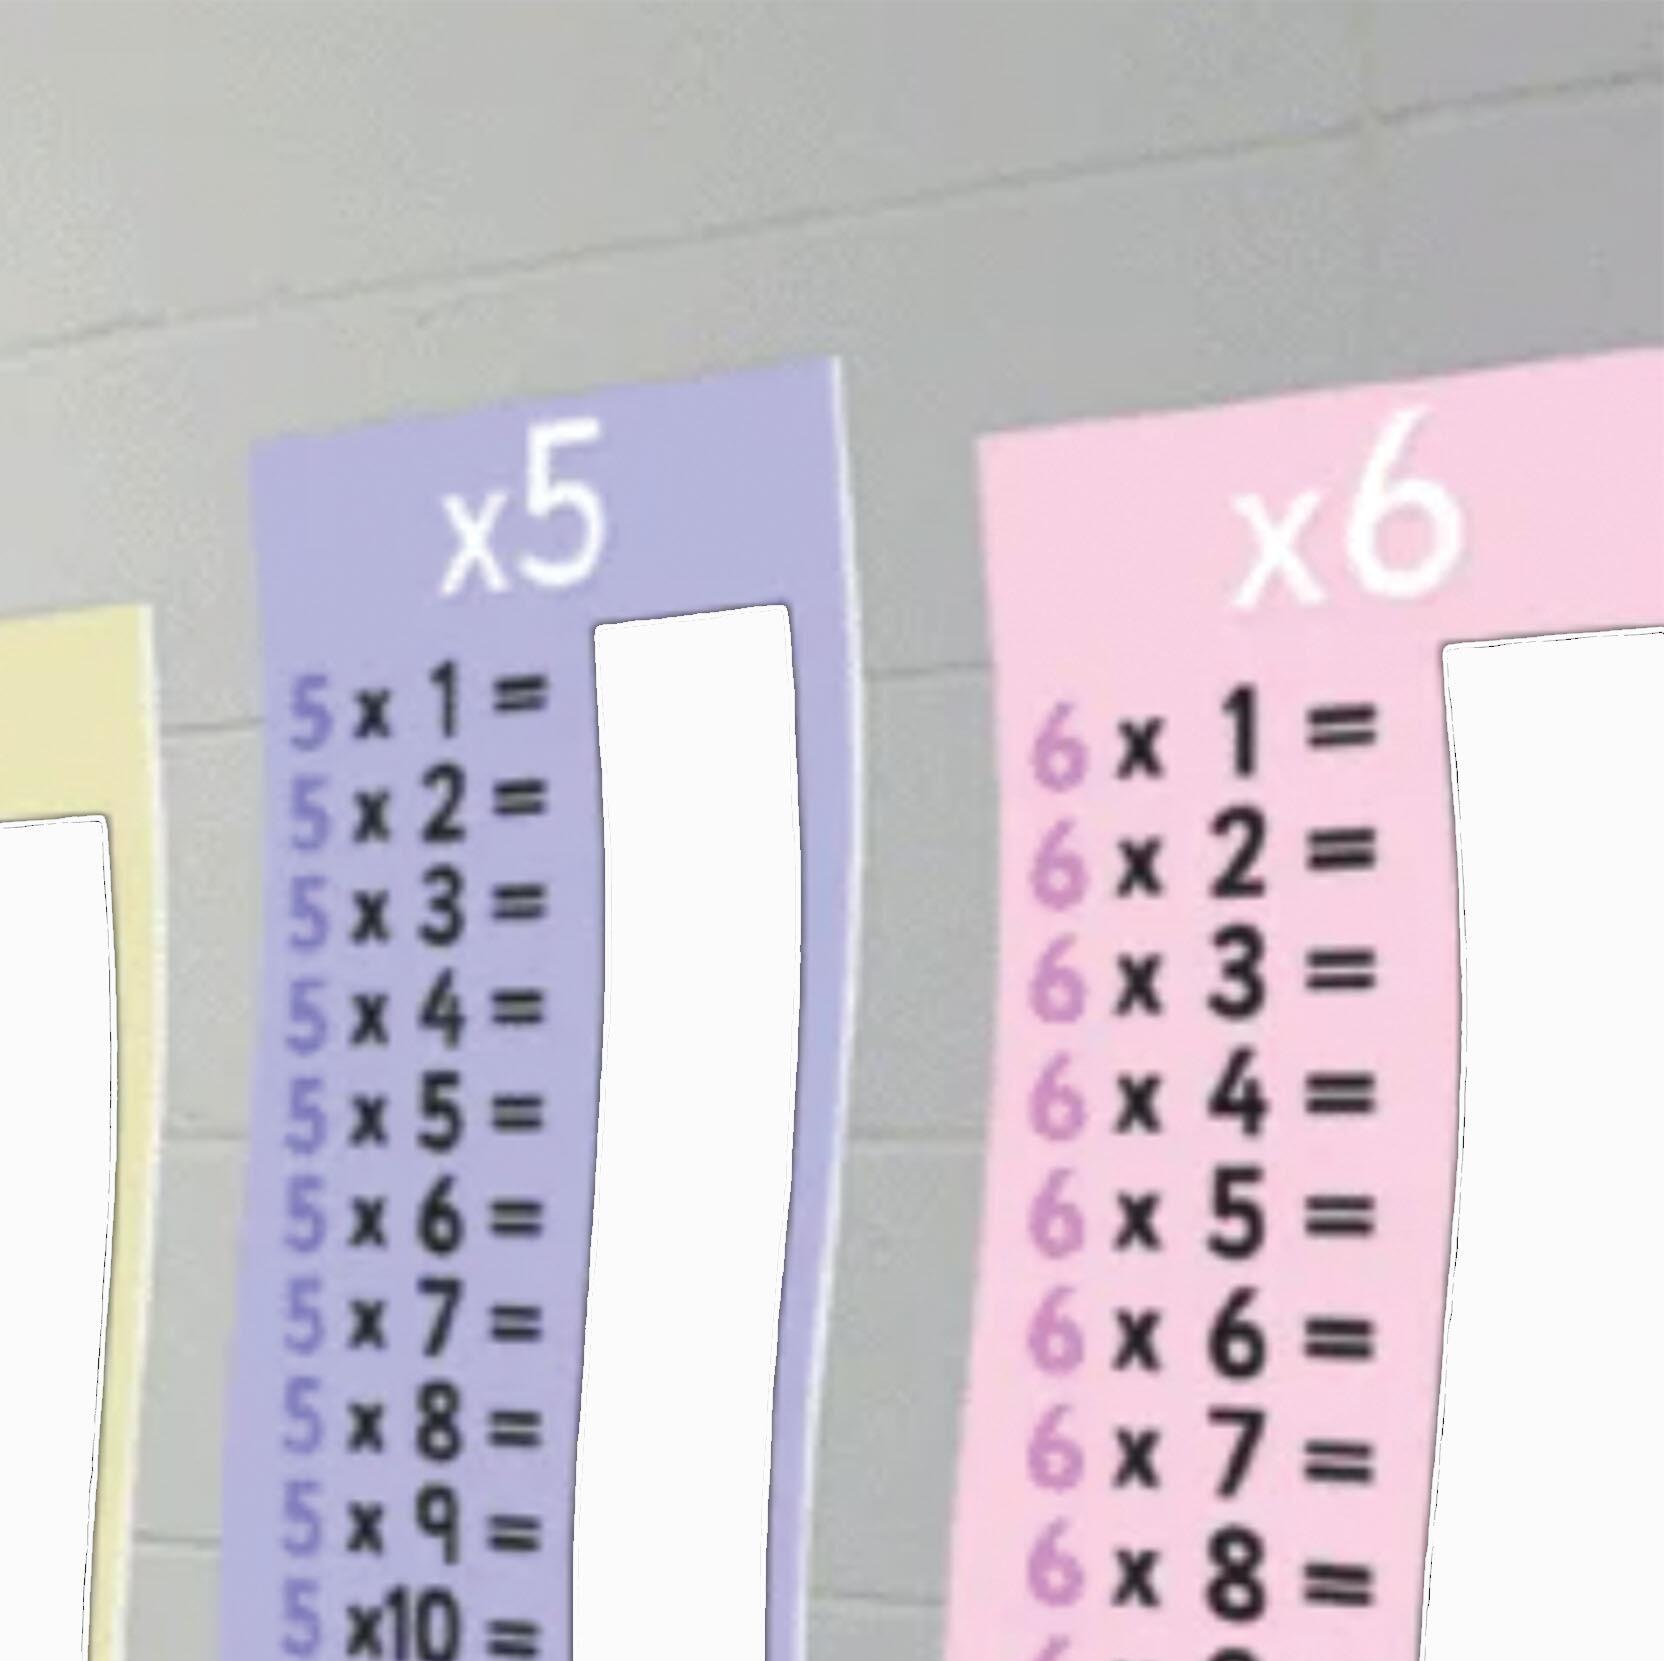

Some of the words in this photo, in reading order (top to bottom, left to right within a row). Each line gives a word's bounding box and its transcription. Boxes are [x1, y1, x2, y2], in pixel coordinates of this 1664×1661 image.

[439, 417, 606, 596] x5
[1229, 406, 1463, 608] x6
[290, 673, 334, 752] 5
[354, 689, 390, 739] x
[429, 659, 458, 739] 1
[1031, 702, 1088, 793] 6
[1117, 717, 1163, 779] x
[1222, 684, 1257, 778] 1
[291, 774, 331, 853] 5
[353, 790, 390, 843] x
[421, 762, 466, 844] 2
[1029, 819, 1089, 912] 6
[1117, 837, 1163, 898] x
[1210, 804, 1267, 899] 2
[289, 874, 330, 954] 5
[351, 891, 390, 944] x
[418, 863, 465, 948] 3
[285, 977, 329, 1057] 5
[350, 993, 389, 1045] x
[418, 968, 467, 1048] 4
[1029, 935, 1087, 1024] 6
[1116, 954, 1162, 1016] x
[1207, 923, 1266, 1021] 3
[1029, 1052, 1087, 1142] 6
[1116, 1074, 1161, 1134] x
[1207, 1046, 1269, 1137] 4
[284, 1174, 327, 1254] 5
[349, 1197, 386, 1247] x
[417, 1174, 465, 1257] 6
[1028, 1168, 1085, 1260] 6
[1115, 1193, 1161, 1251] x
[1207, 1165, 1265, 1261] 5
[283, 1375, 324, 1455] 5
[348, 1403, 384, 1453] x
[415, 1379, 463, 1464] 8
[1027, 1404, 1085, 1493] 6
[1114, 1428, 1160, 1489] x
[1207, 1406, 1266, 1499] 7
[283, 1479, 322, 1558] 5
[346, 1502, 384, 1555] x
[415, 1483, 460, 1565] 9
[281, 1578, 322, 1659] 5
[1027, 1519, 1085, 1608] 6
[1112, 1549, 1160, 1608] x
[1205, 1524, 1266, 1624] 8
